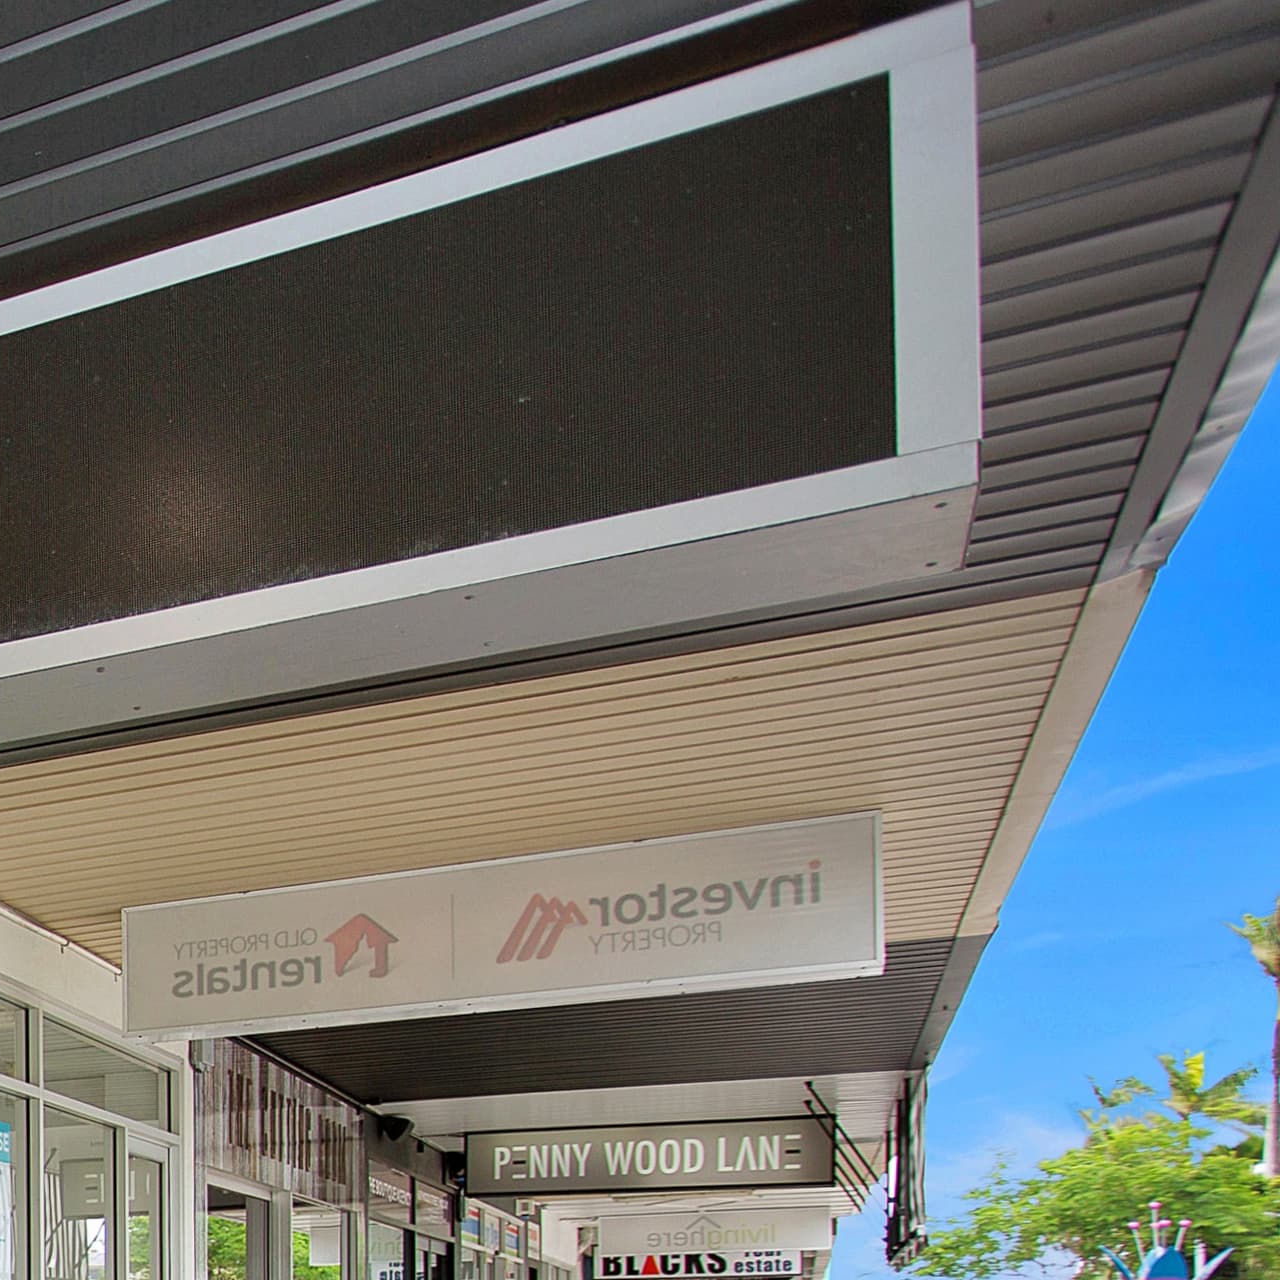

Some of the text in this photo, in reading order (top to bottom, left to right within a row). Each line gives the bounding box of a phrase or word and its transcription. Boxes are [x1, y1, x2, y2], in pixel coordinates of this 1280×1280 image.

[493, 1134, 803, 1180] PENNY WOOD LANE
[602, 1253, 727, 1276] BLACKS
[734, 1259, 793, 1273] estate
